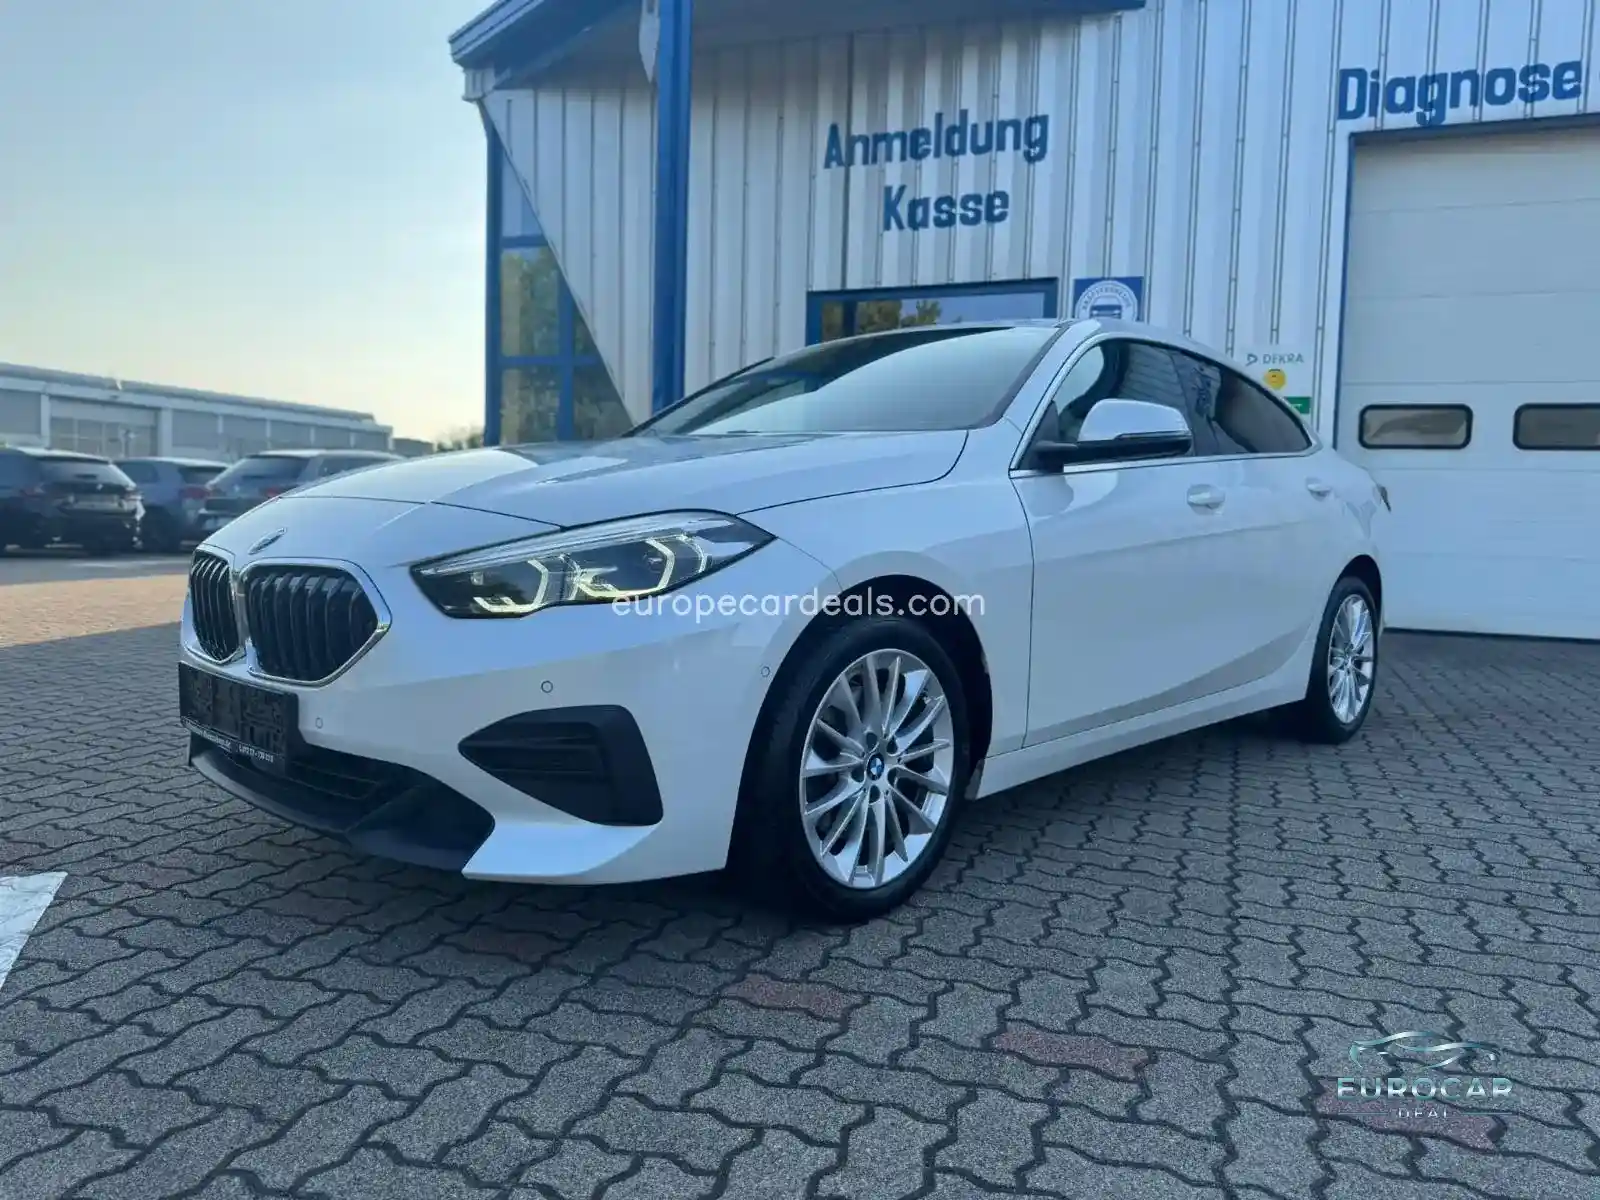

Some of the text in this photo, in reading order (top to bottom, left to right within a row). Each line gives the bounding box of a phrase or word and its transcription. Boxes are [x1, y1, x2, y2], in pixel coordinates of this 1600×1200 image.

[1337, 61, 1582, 126] Diagnose
[824, 109, 1049, 169] Anmeldung
[883, 185, 1009, 231] Kasse
[1262, 353, 1304, 364] DEKRA
